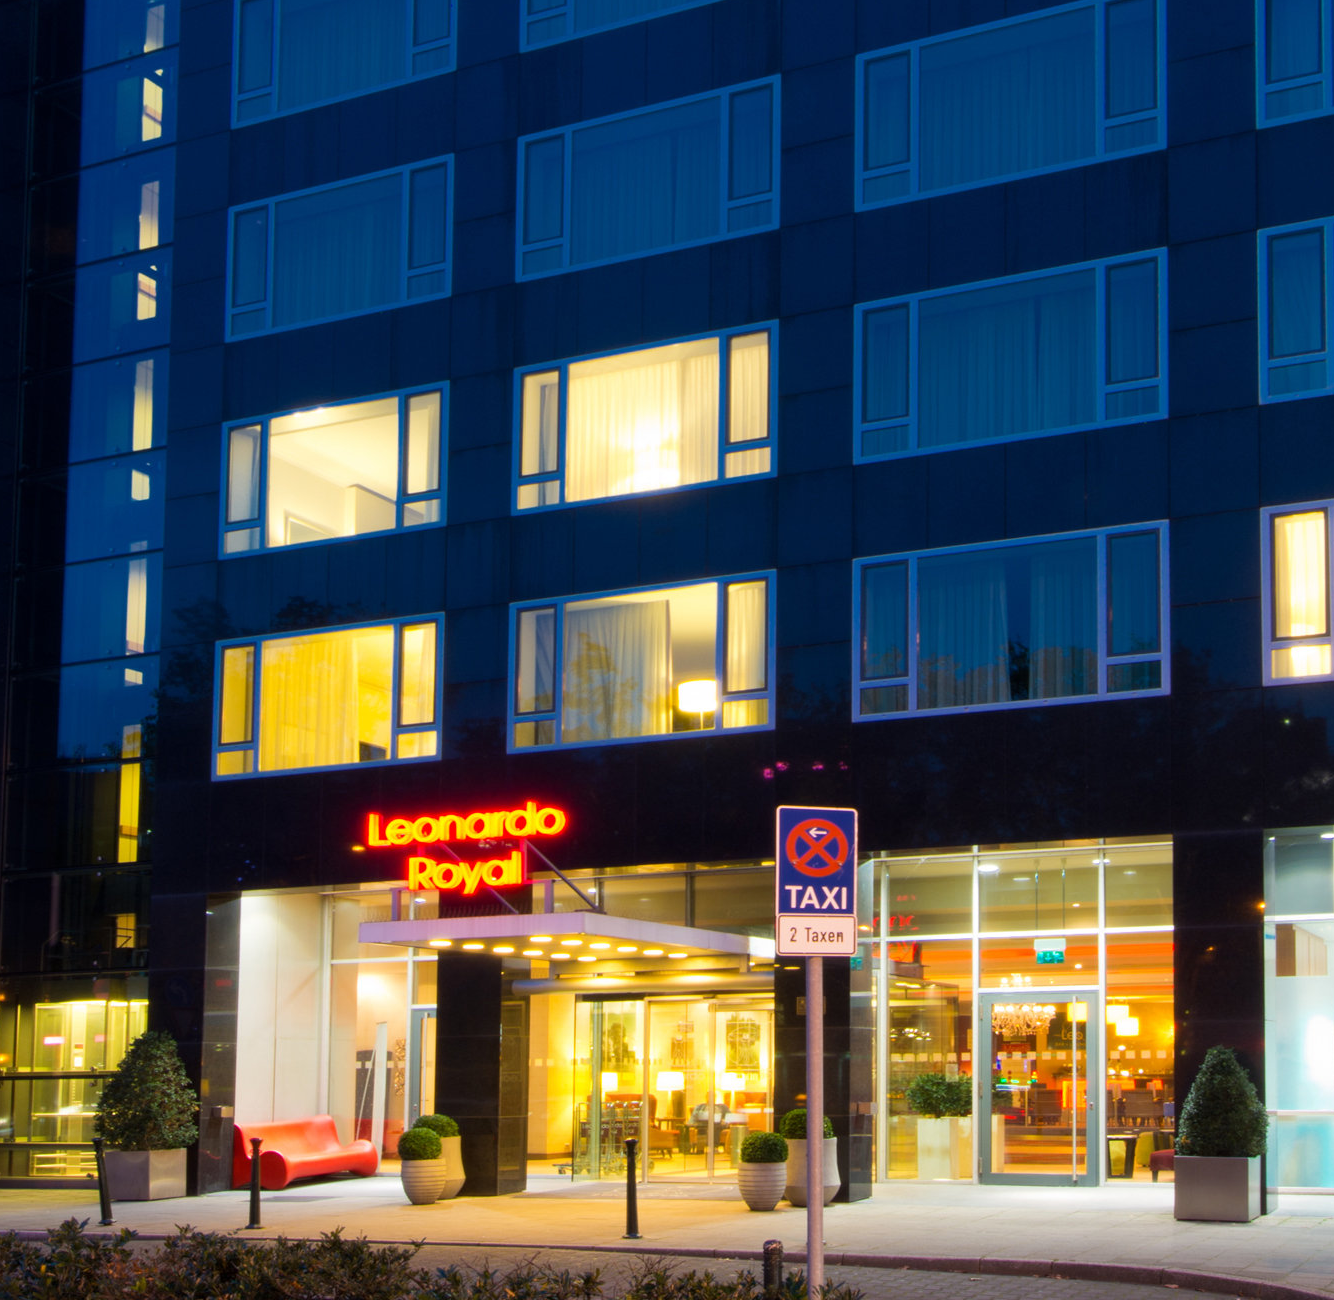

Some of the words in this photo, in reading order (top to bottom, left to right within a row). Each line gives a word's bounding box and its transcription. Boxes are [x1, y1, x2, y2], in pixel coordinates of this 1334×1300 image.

[368, 801, 566, 847] Leonardo
[408, 850, 523, 895] Royal
[785, 885, 848, 910] TAXI
[789, 927, 798, 942] 2
[804, 927, 844, 943] Taxen
